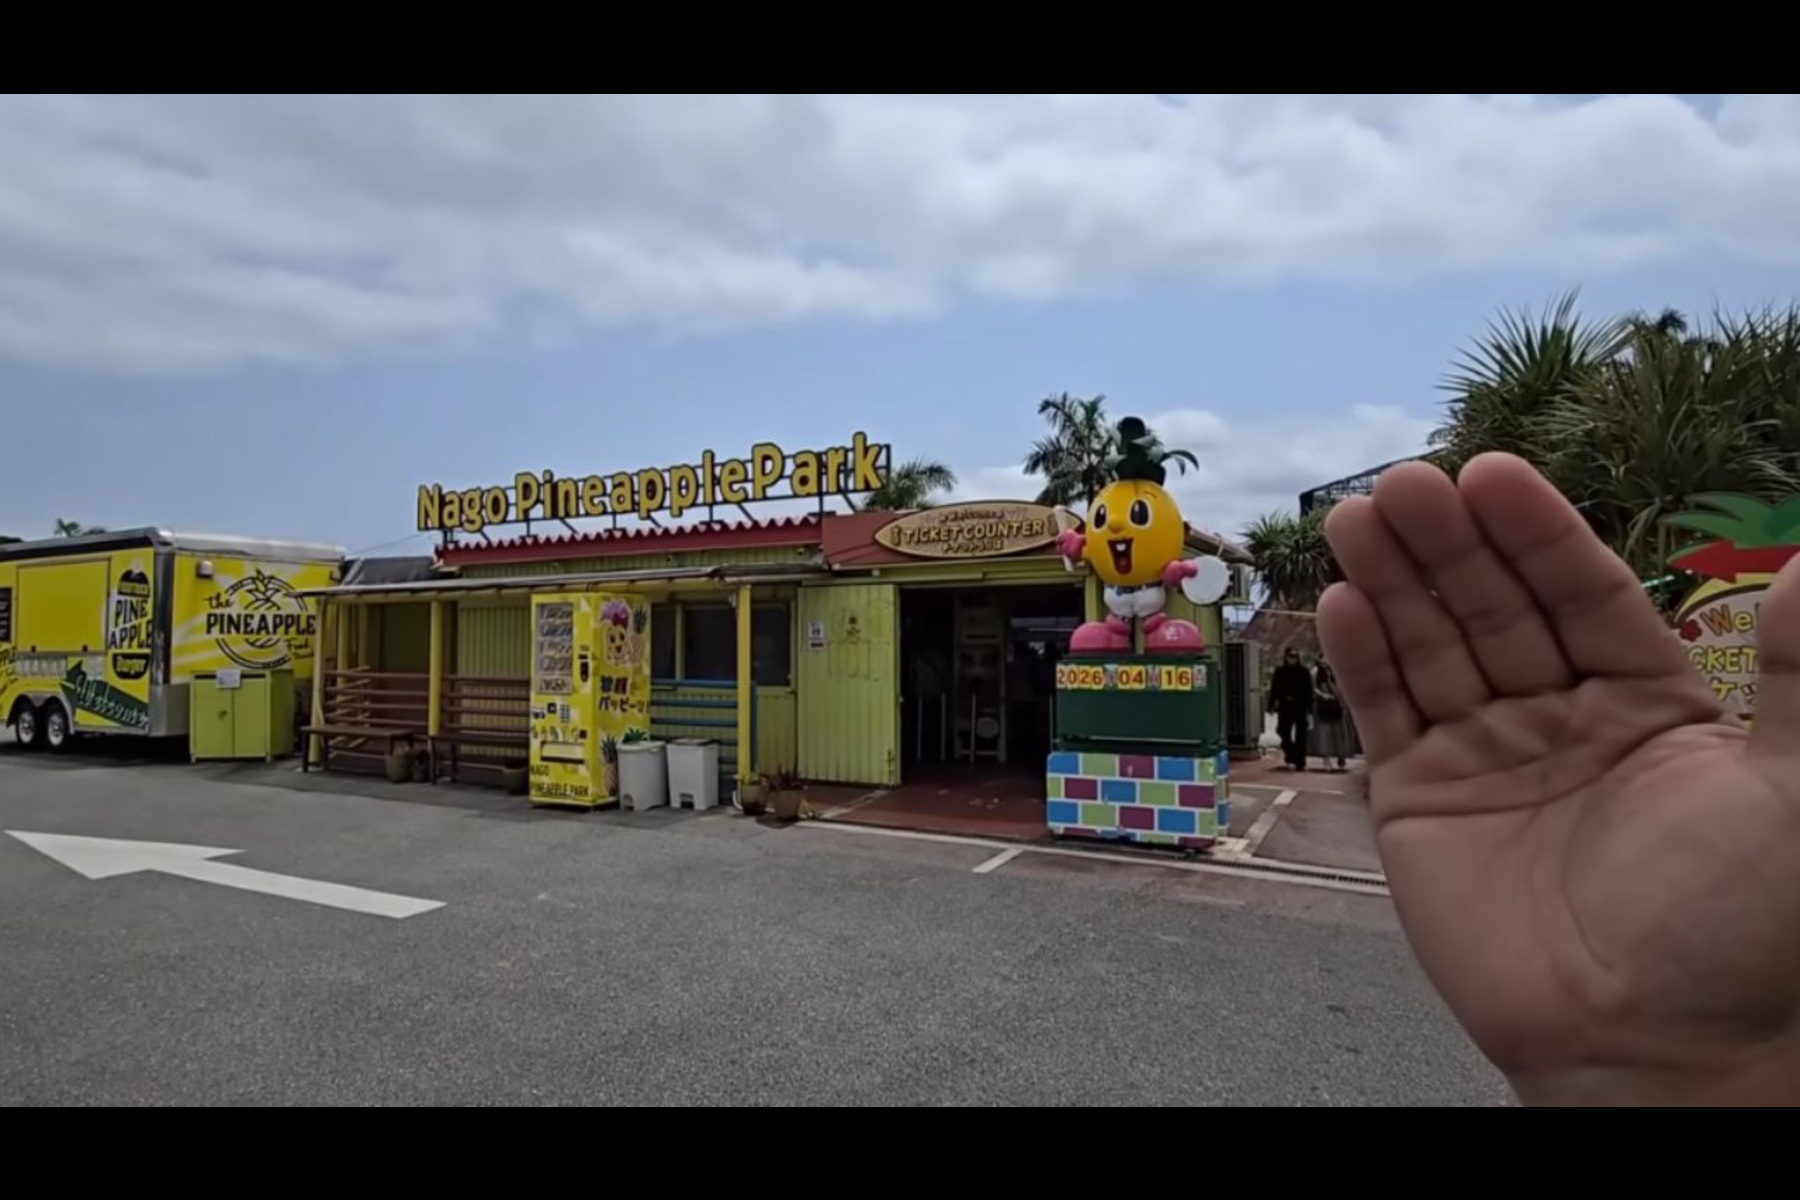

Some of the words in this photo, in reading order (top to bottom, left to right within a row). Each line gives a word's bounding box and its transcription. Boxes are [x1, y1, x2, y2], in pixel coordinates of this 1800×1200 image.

[417, 484, 508, 533] Nago
[515, 450, 748, 521] Pineapple
[751, 431, 886, 500] Park
[903, 527, 962, 545] TICKET
[962, 519, 1045, 541] COUNTER
[115, 599, 147, 629] PINE
[204, 592, 234, 610] the
[109, 620, 153, 649] APPLE
[206, 613, 316, 635] PINEAPPLE
[1057, 668, 1103, 687] 2026
[1119, 669, 1144, 687] 04
[1163, 669, 1190, 688] 16
